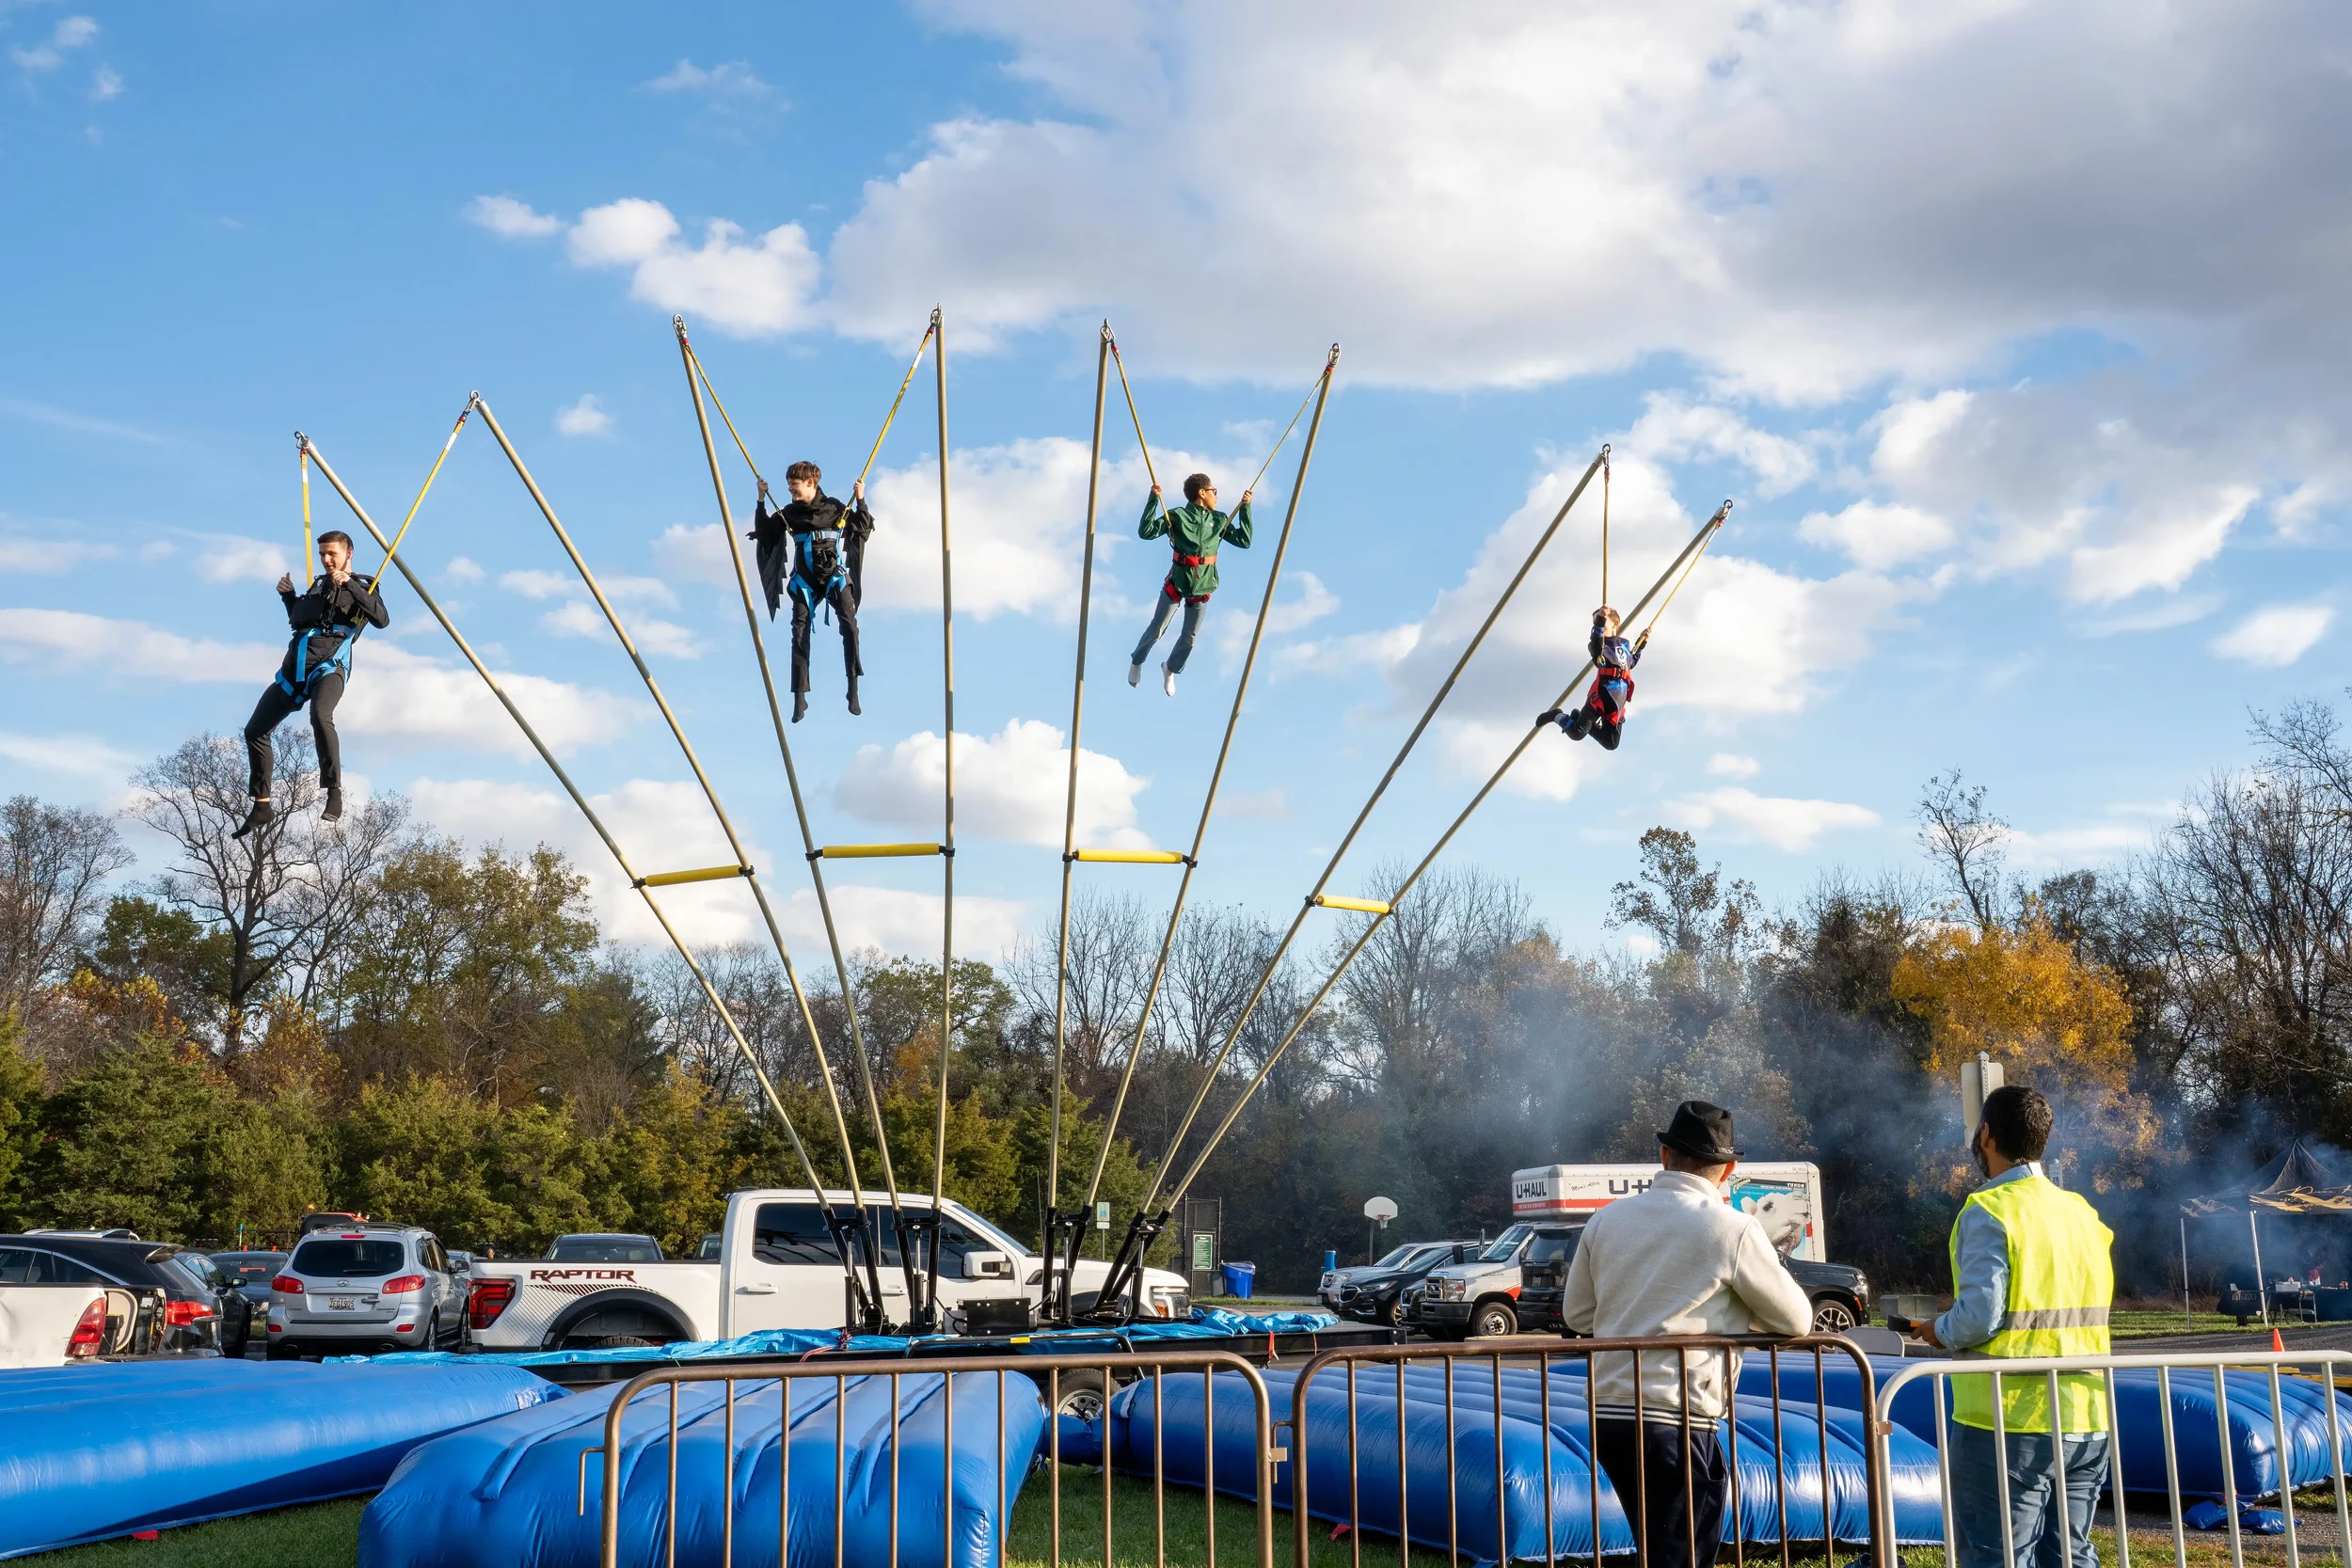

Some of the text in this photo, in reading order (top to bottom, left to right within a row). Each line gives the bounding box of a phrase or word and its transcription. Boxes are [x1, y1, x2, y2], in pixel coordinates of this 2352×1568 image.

[1516, 1181, 1548, 1198] U-HAUL
[1609, 1179, 1653, 1195] U-H
[530, 1270, 638, 1284] RAPTOR
